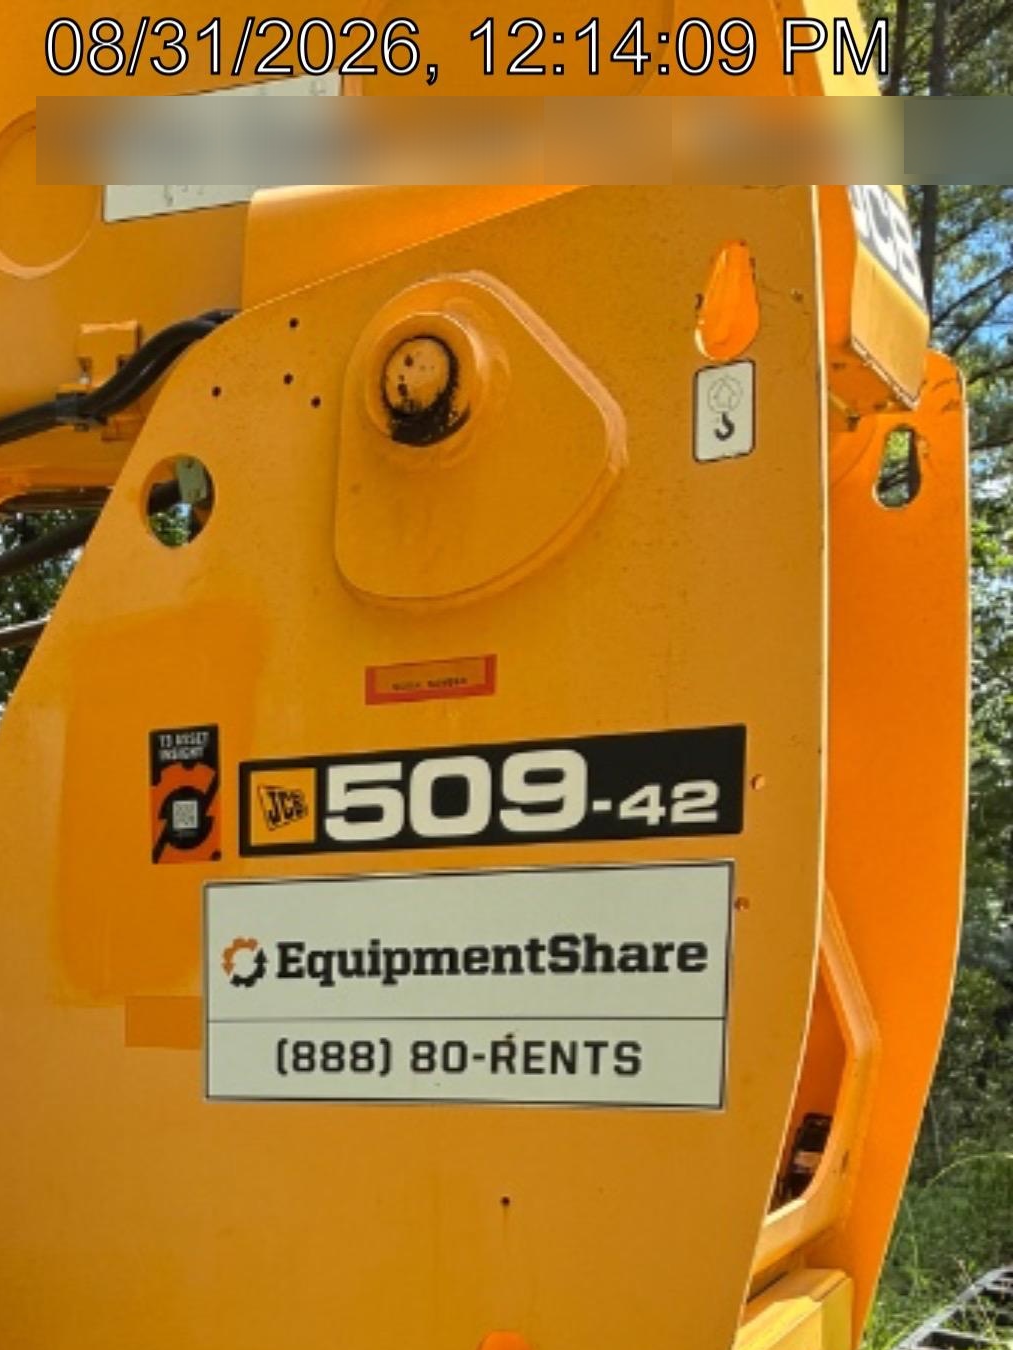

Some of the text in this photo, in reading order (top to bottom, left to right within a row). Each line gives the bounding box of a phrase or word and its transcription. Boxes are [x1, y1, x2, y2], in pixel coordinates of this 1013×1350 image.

[262, 749, 720, 841] JCB 509-42
[275, 933, 708, 987] EquipmentShare
[276, 1038, 643, 1079] (888) 80-RENTS
